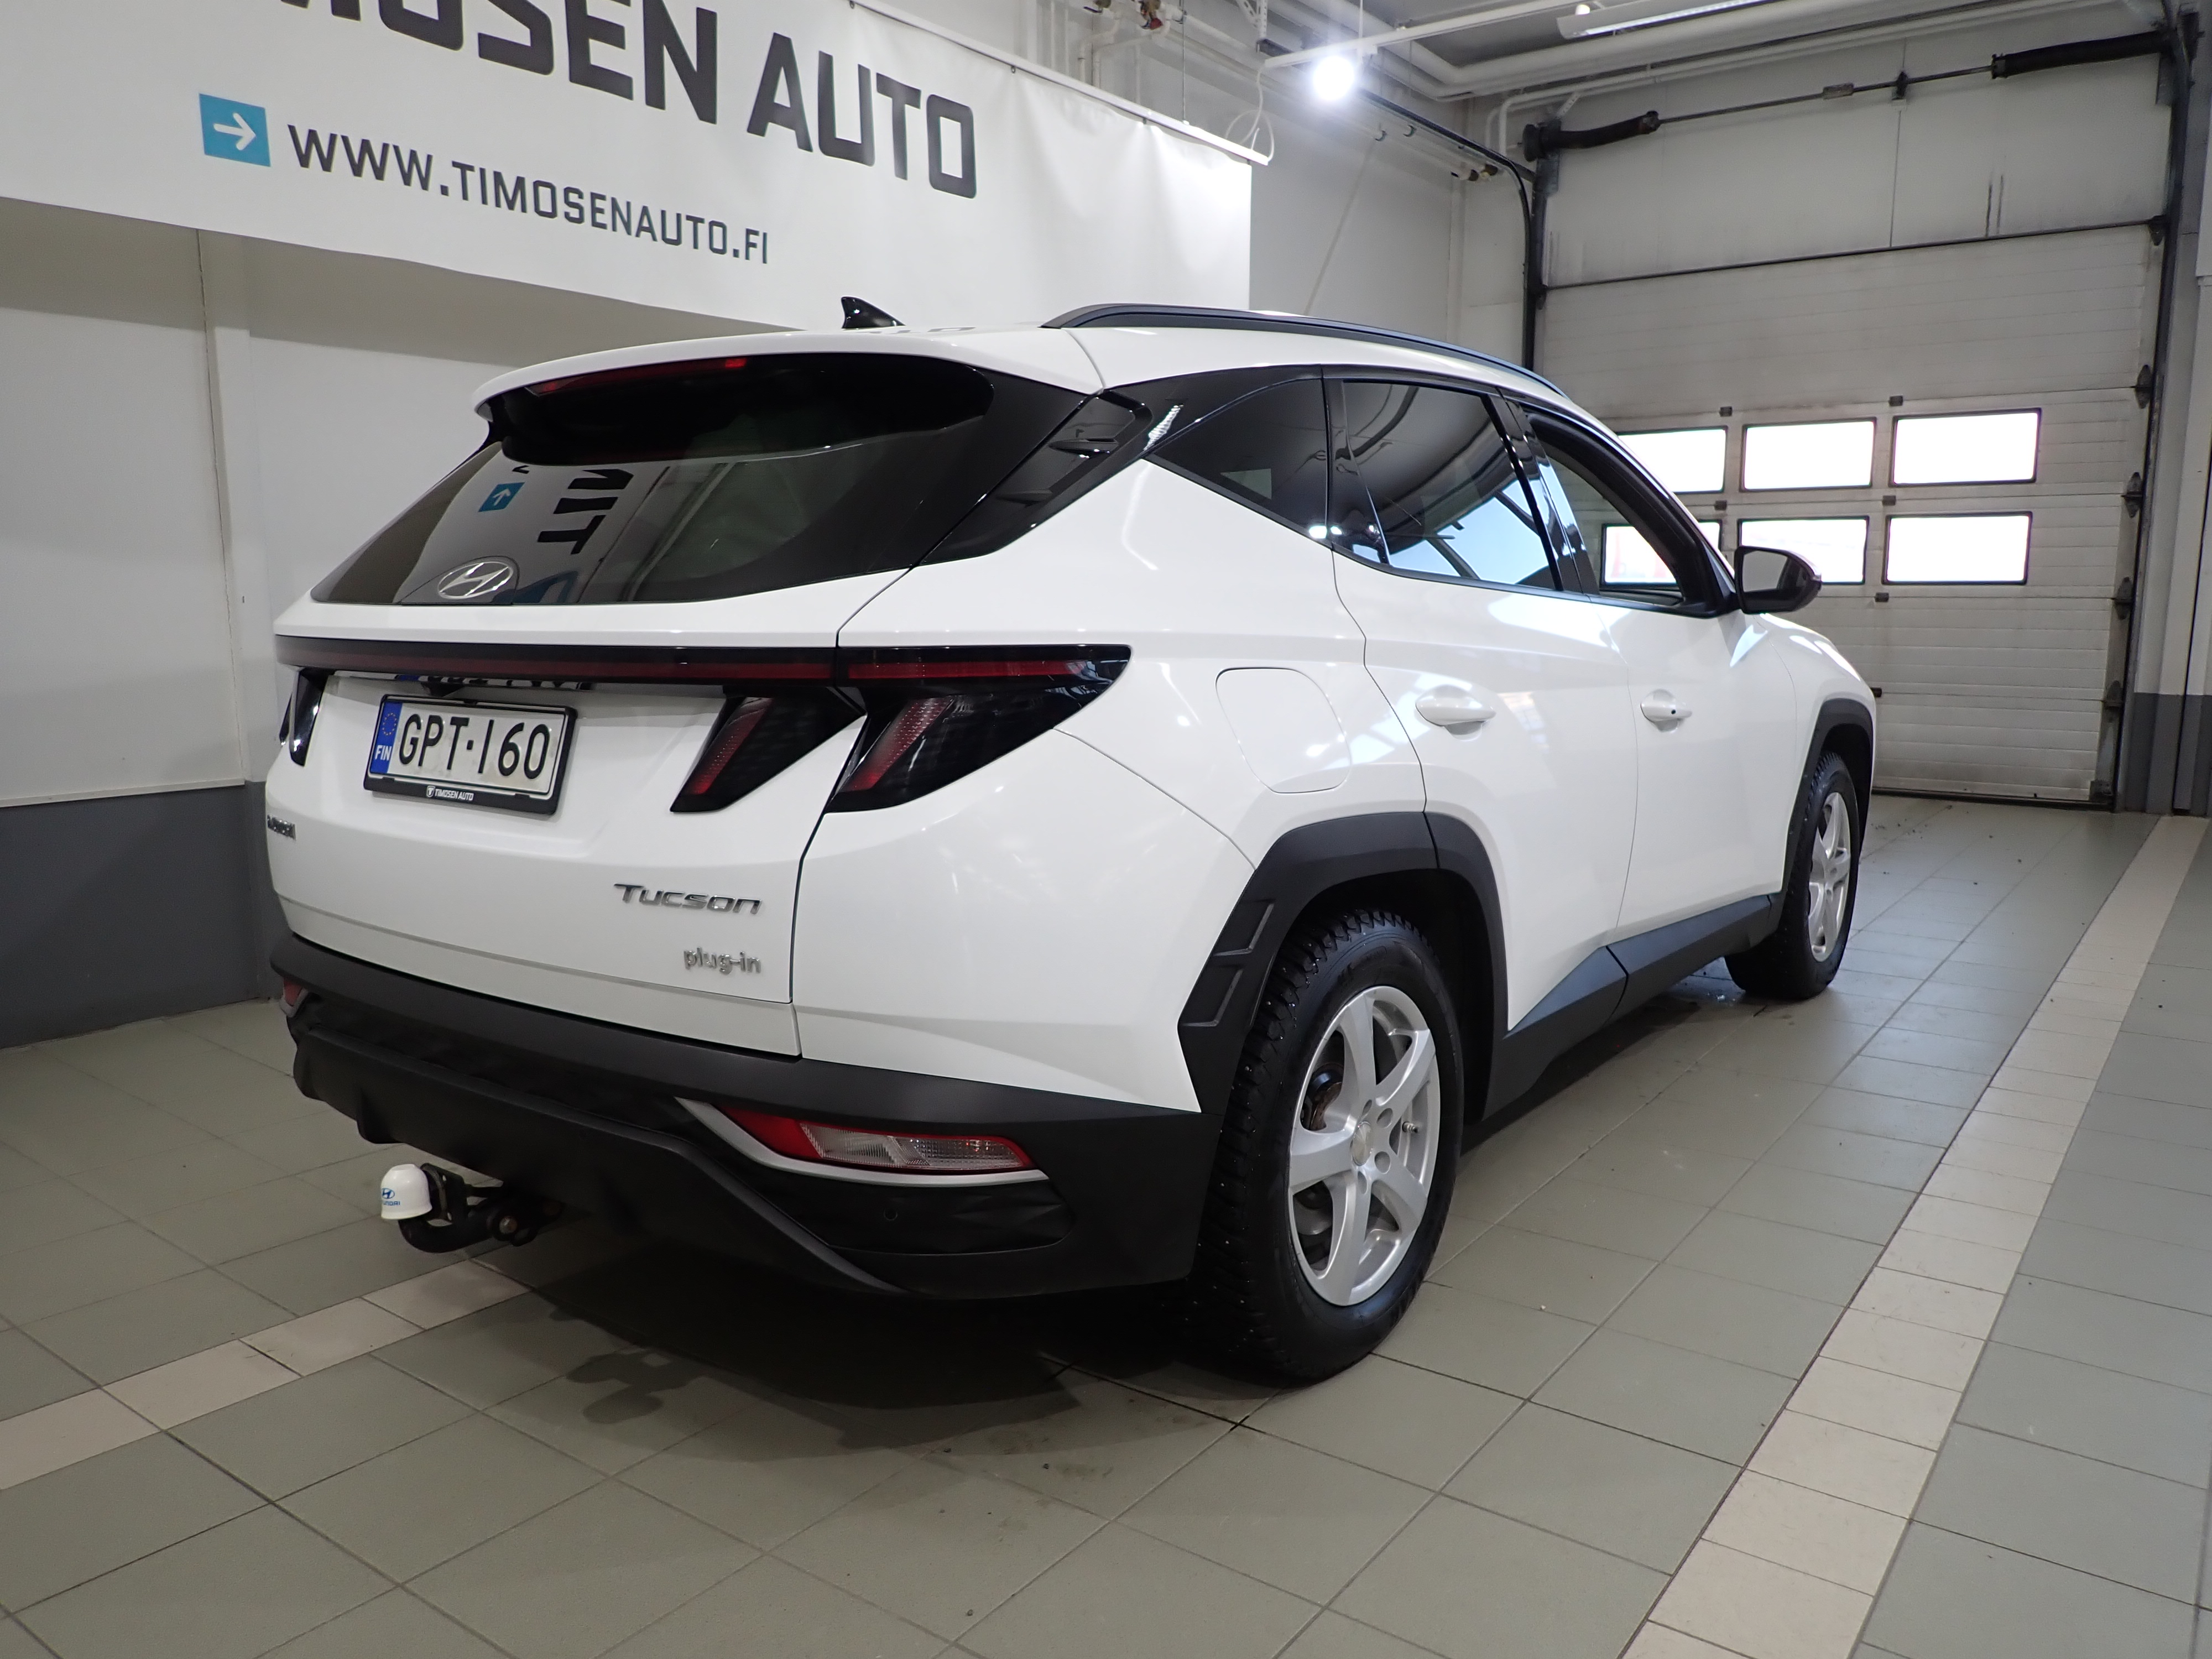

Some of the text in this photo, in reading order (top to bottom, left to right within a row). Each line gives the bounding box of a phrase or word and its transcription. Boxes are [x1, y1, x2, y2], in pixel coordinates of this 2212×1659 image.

[747, 32, 977, 199] AUTO
[288, 124, 768, 264] WWW.TIMOSENAUTO.FI
[374, 744, 393, 761] FIN
[435, 788, 458, 799] TIMOSEN
[458, 792, 474, 801] AUTO
[684, 946, 761, 975] plug-in
